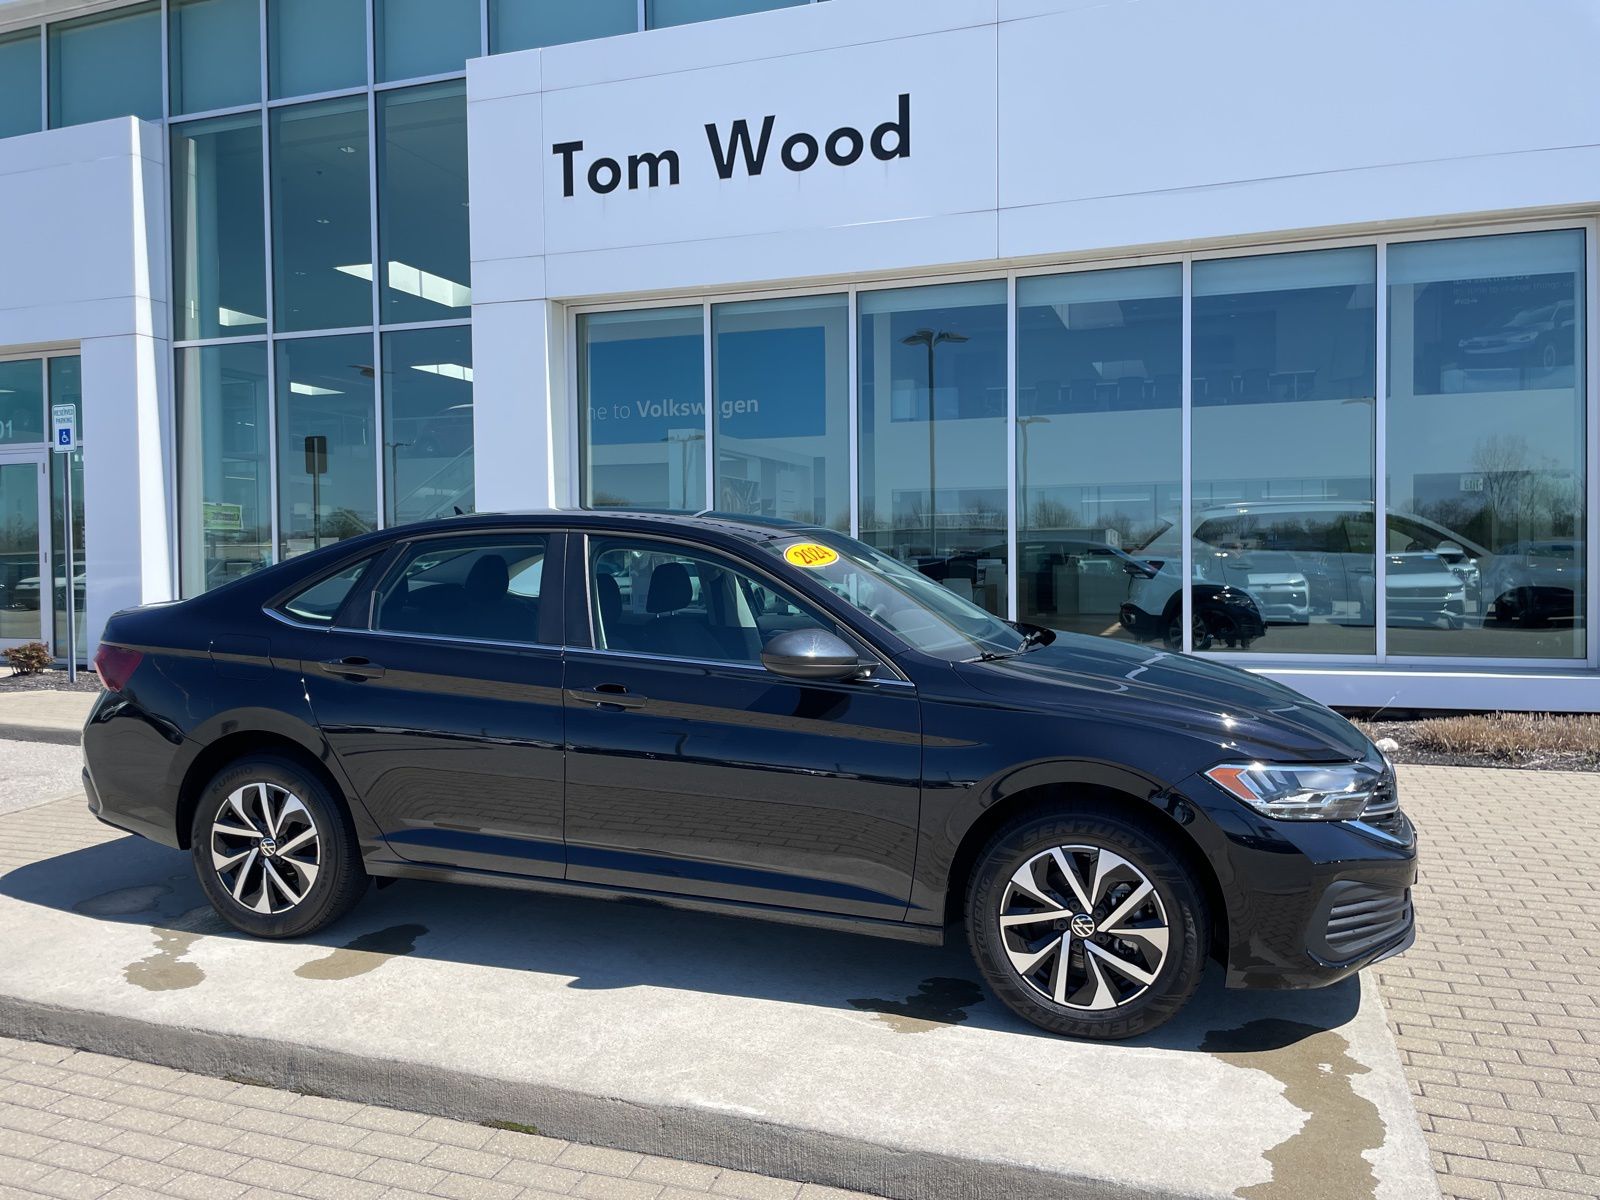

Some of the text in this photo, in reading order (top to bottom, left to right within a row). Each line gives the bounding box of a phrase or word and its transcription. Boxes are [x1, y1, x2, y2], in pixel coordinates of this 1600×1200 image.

[552, 93, 911, 198] Tom Wood
[613, 404, 631, 419] to
[636, 399, 759, 419] Volkswgen
[793, 545, 832, 565] 2024
[1022, 820, 1156, 854] SENTURY
[1011, 999, 1144, 1036] SENTURY
